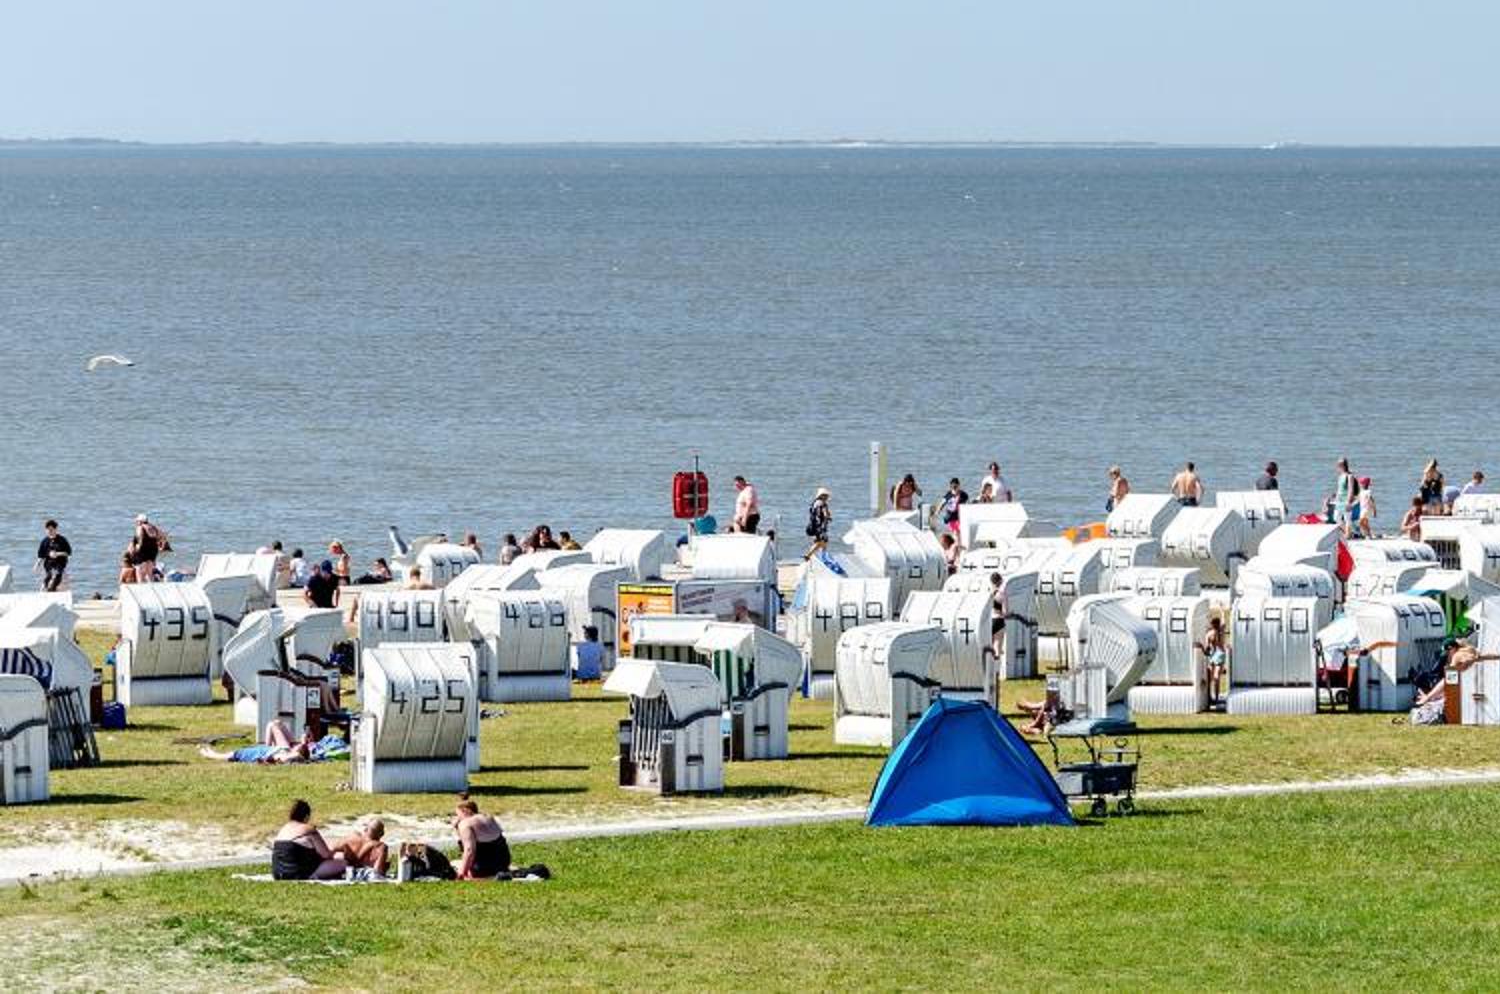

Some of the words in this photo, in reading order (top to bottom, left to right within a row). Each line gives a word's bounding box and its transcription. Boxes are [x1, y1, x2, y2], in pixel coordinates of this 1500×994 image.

[141, 607, 209, 641] 435
[1144, 608, 1188, 633] 98
[1238, 608, 1309, 634] 490
[391, 678, 464, 714] 425
